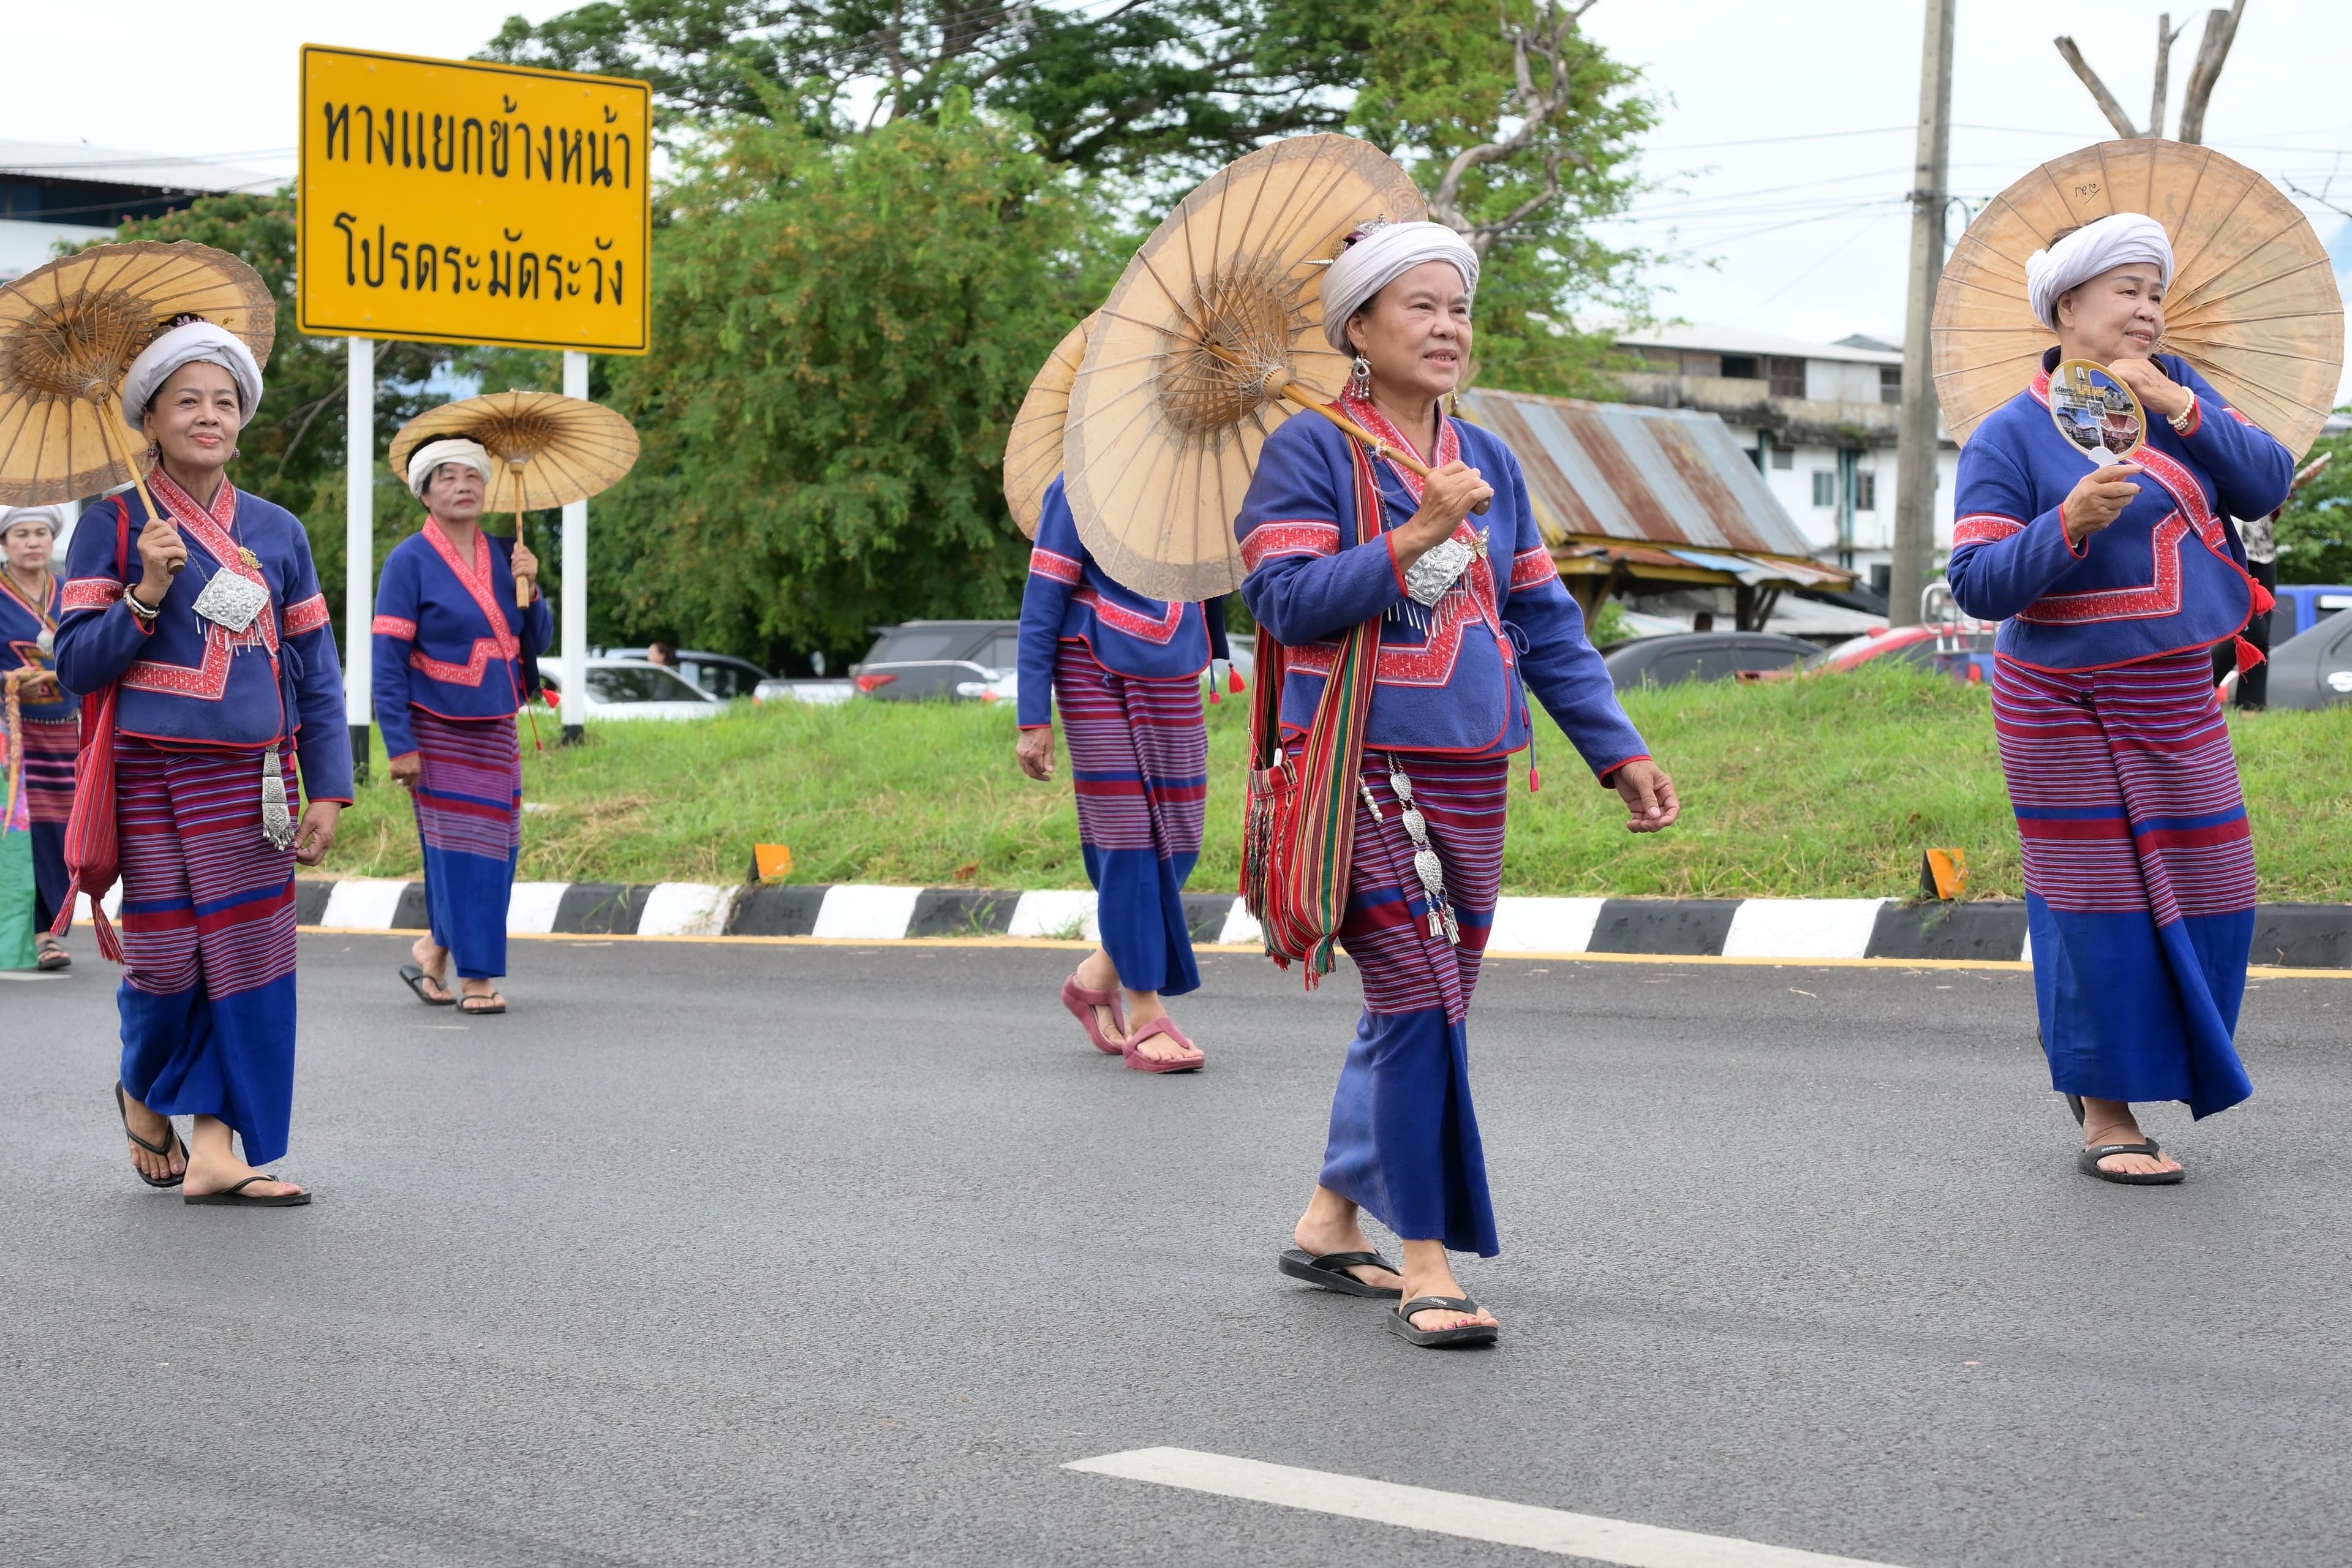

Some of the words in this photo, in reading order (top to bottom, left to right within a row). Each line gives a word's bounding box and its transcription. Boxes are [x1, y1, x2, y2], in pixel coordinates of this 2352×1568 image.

[323, 93, 631, 189] ทางแยกข้างหน้า
[334, 211, 622, 306] โปรดระมัดระวัง
